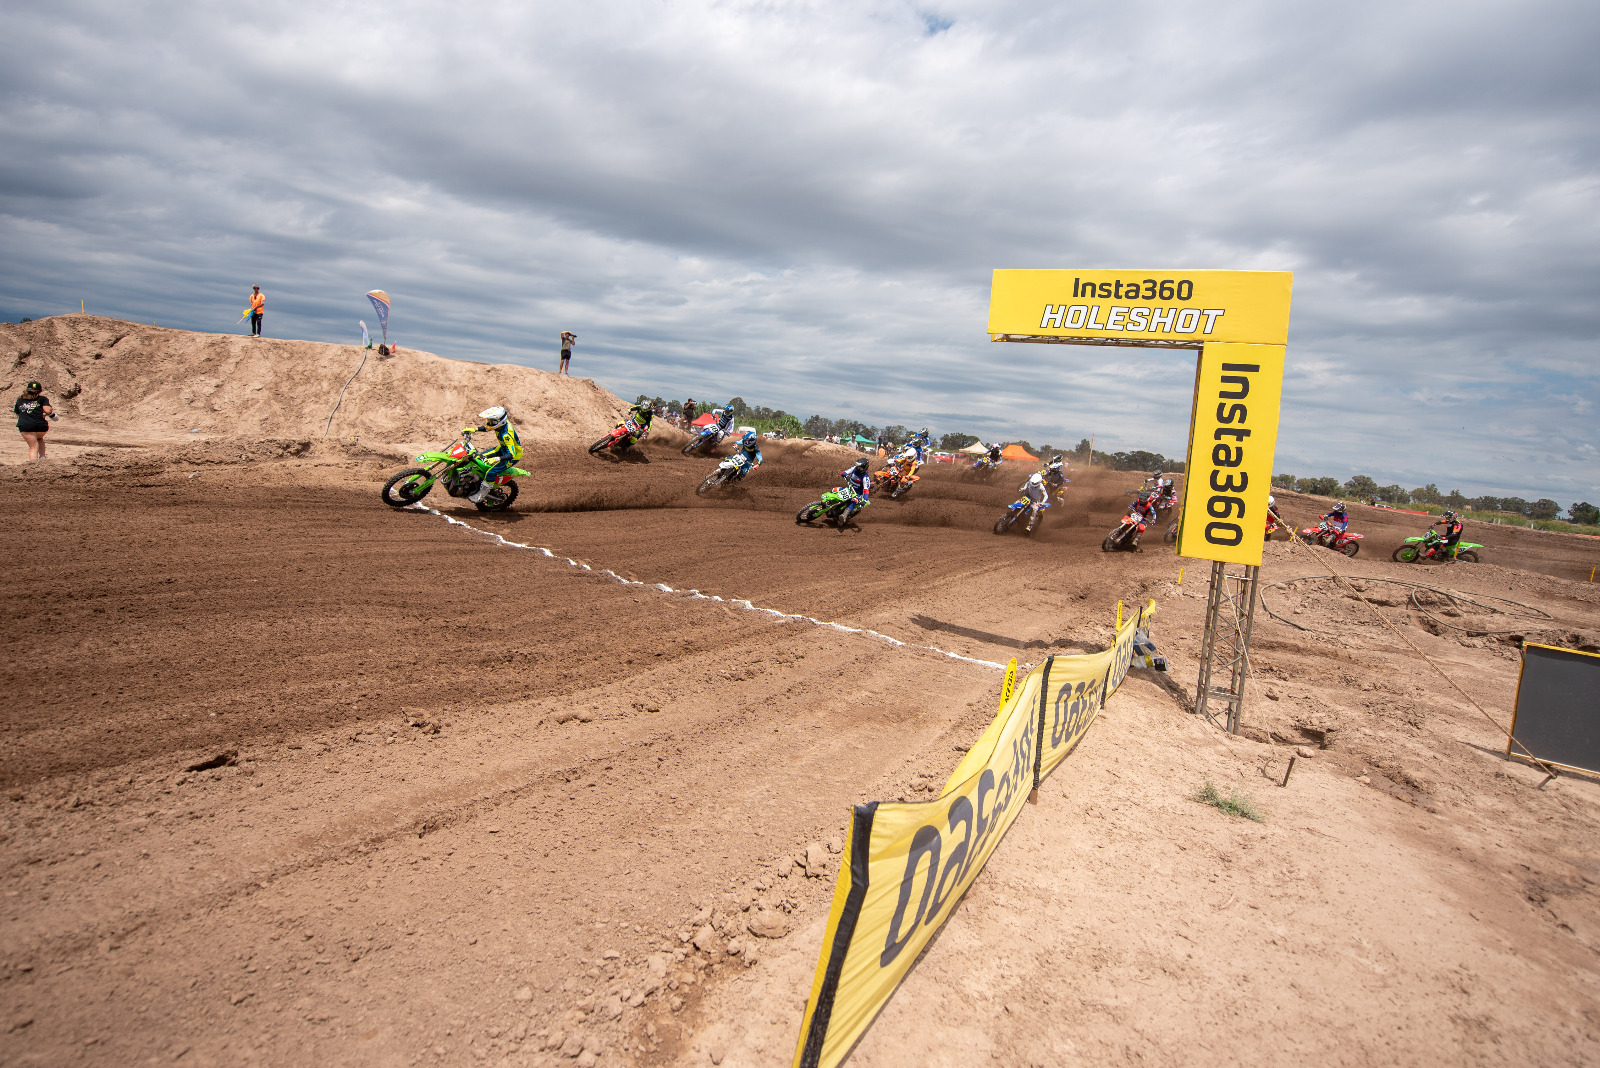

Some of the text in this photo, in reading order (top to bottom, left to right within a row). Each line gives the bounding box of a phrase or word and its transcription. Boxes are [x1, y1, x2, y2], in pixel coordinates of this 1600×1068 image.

[1072, 277, 1194, 301] Insta360
[1040, 304, 1225, 335] HOLESHOT
[451, 446, 464, 456] 1
[1204, 362, 1260, 547] Insta360
